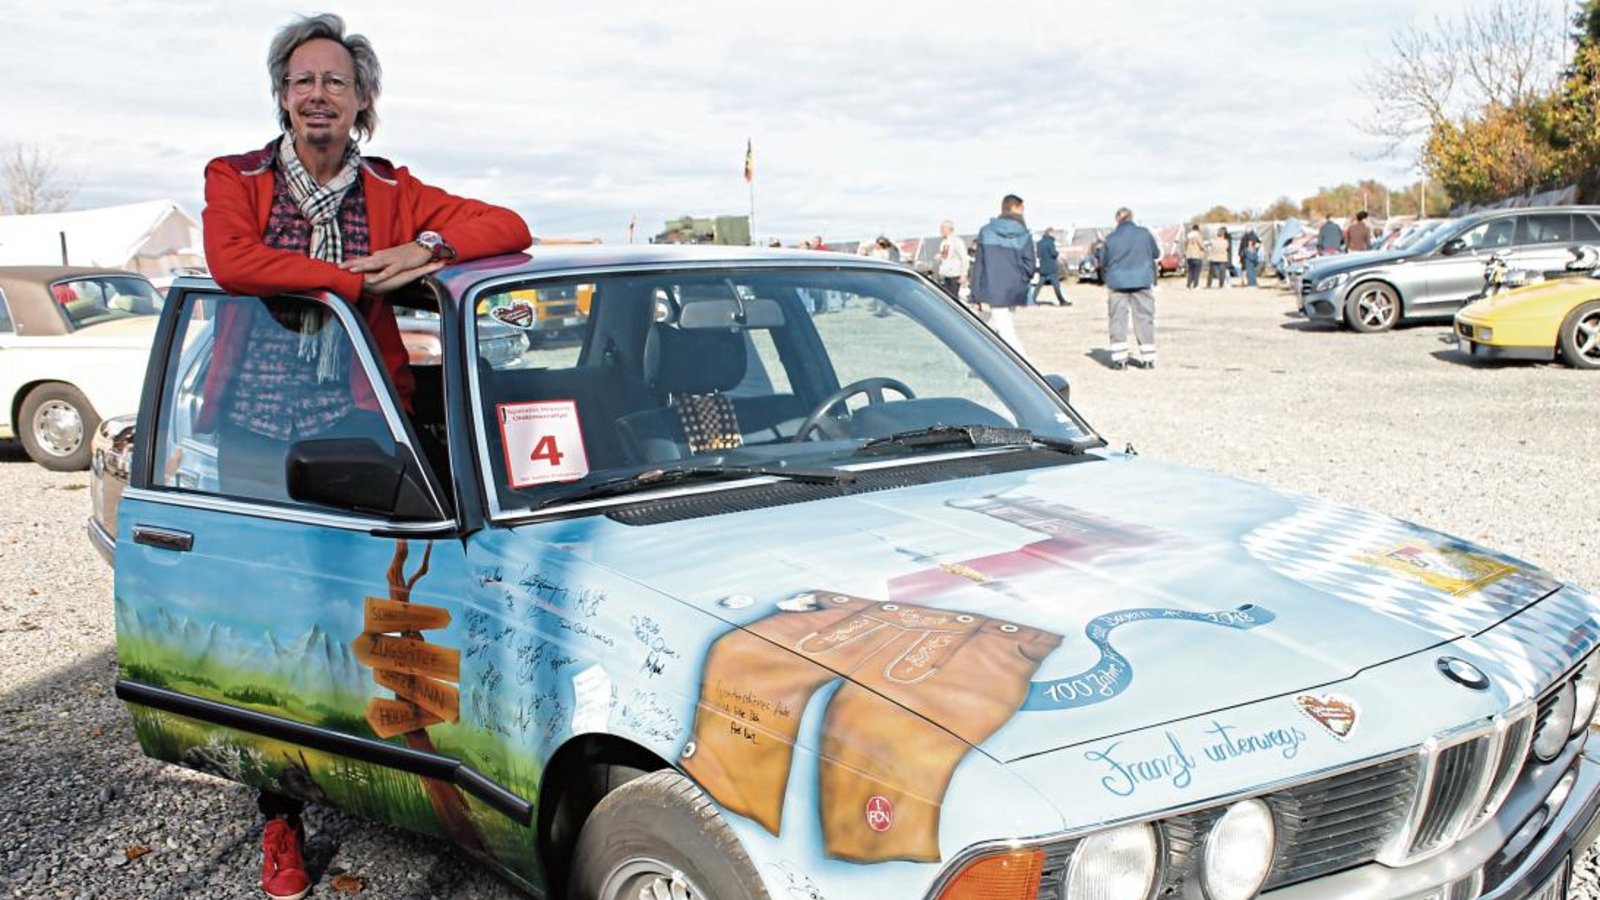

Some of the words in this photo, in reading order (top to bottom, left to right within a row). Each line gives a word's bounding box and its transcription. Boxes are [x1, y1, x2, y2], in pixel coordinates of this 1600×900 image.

[530, 435, 564, 466] 4
[1207, 611, 1255, 625] 2018
[1044, 680, 1093, 702] 100
[1084, 731, 1196, 797] Franzl
[1204, 721, 1307, 762] unterwegs
